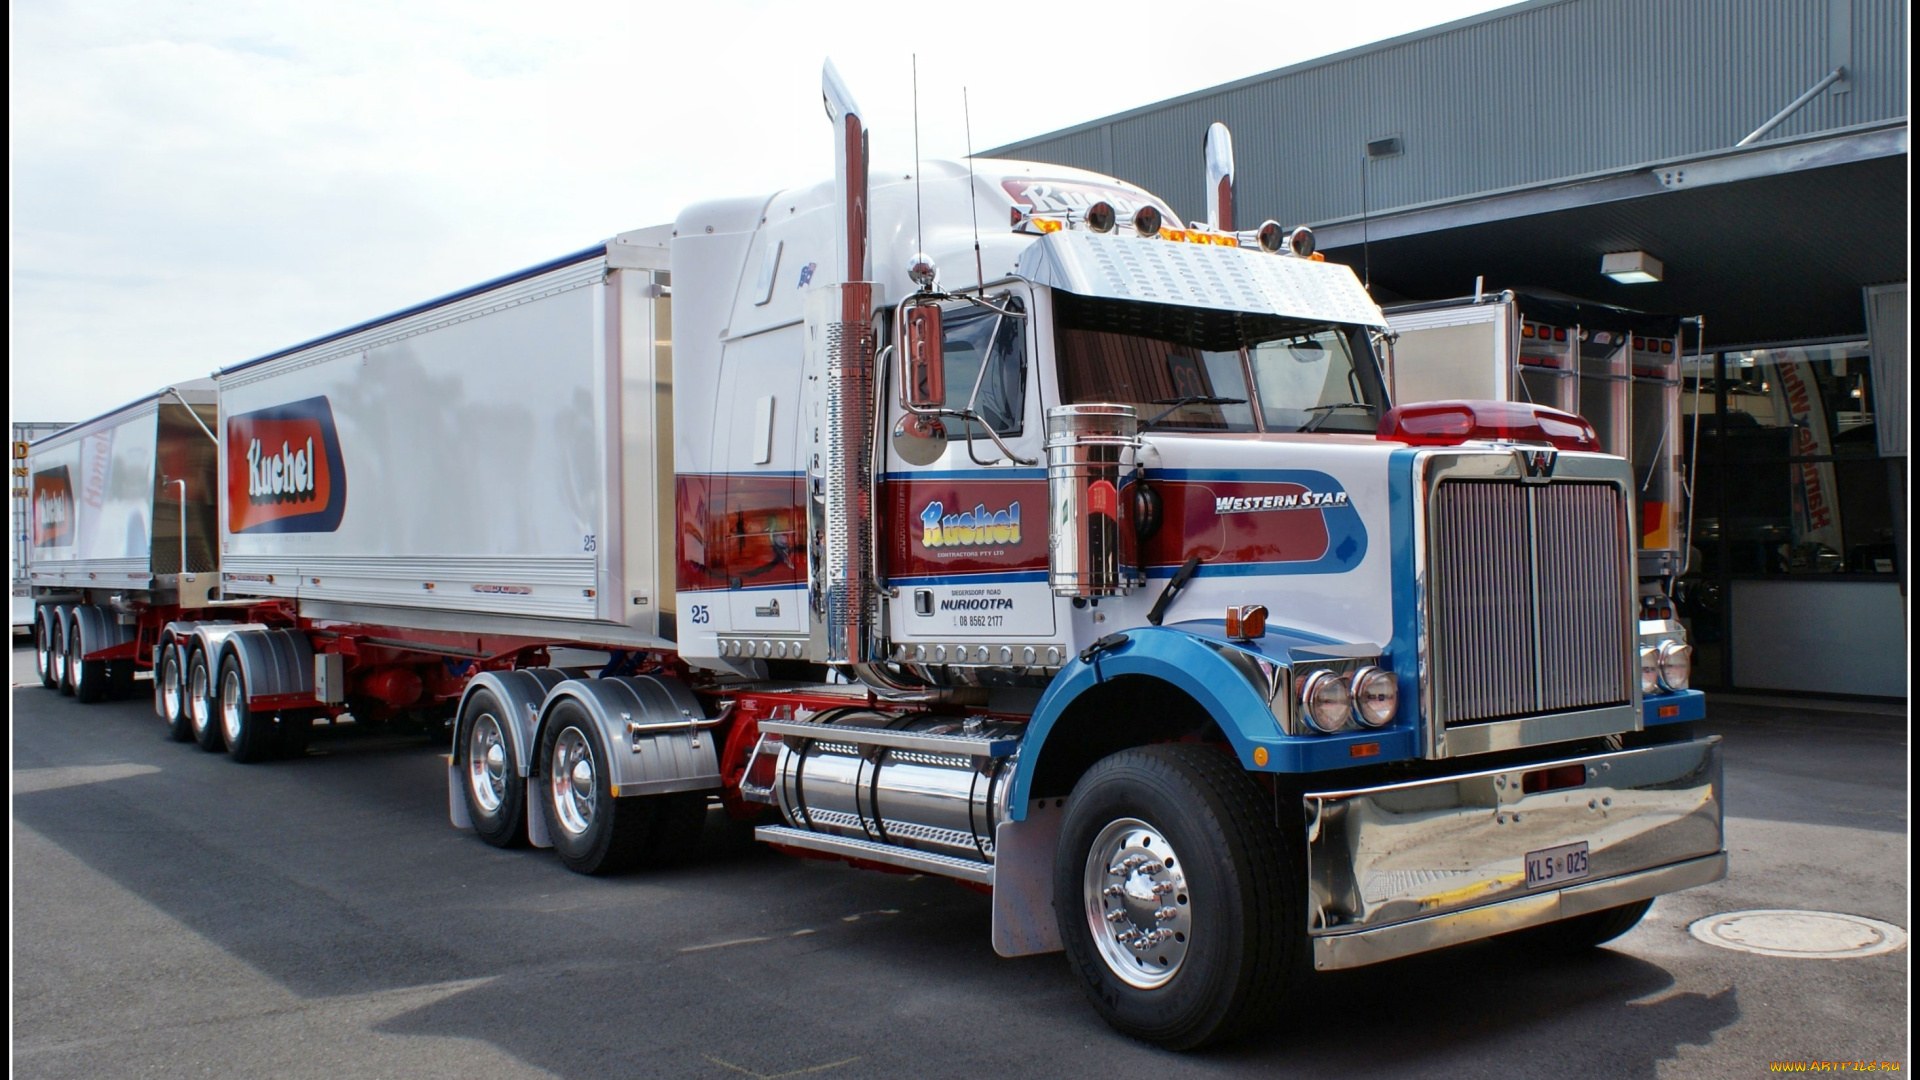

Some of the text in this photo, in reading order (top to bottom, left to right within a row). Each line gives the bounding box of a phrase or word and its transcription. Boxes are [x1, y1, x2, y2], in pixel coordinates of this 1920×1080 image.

[1021, 185, 1141, 212] Kuch
[246, 435, 315, 498] Kuchel
[1215, 491, 1348, 511] WESTERN STAR
[920, 500, 1022, 548] Kuchel
[584, 535, 597, 552] 25
[691, 604, 710, 624] 25
[940, 598, 1014, 611] NURIOOTPA
[959, 615, 1004, 627] 08 8562 2177
[1528, 850, 1587, 882] KLS 025
